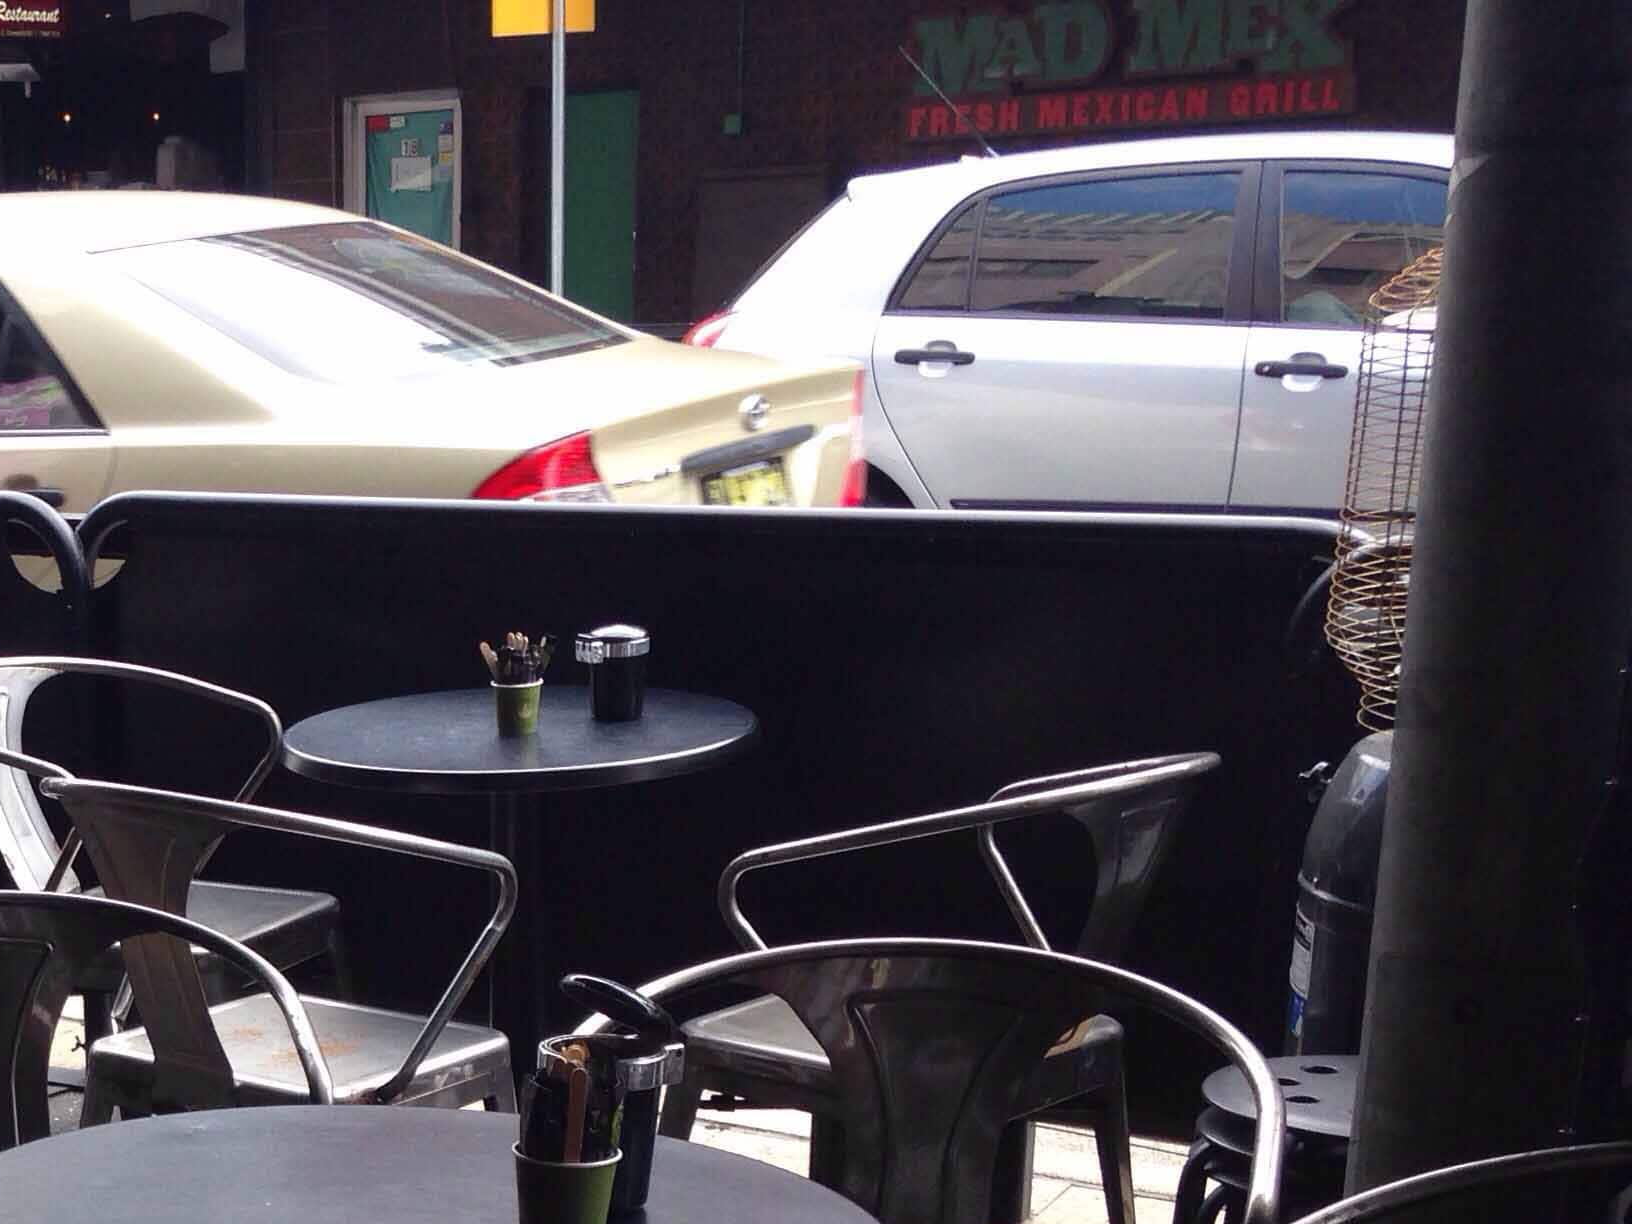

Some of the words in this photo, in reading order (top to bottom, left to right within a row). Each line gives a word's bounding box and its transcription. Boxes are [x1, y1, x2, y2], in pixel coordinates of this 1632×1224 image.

[914, 3, 1107, 96] MAD
[1125, 0, 1345, 73] MEX
[905, 101, 1021, 138] FRESH
[1035, 88, 1210, 128] MEXICAN
[1230, 79, 1342, 115] GRILL
